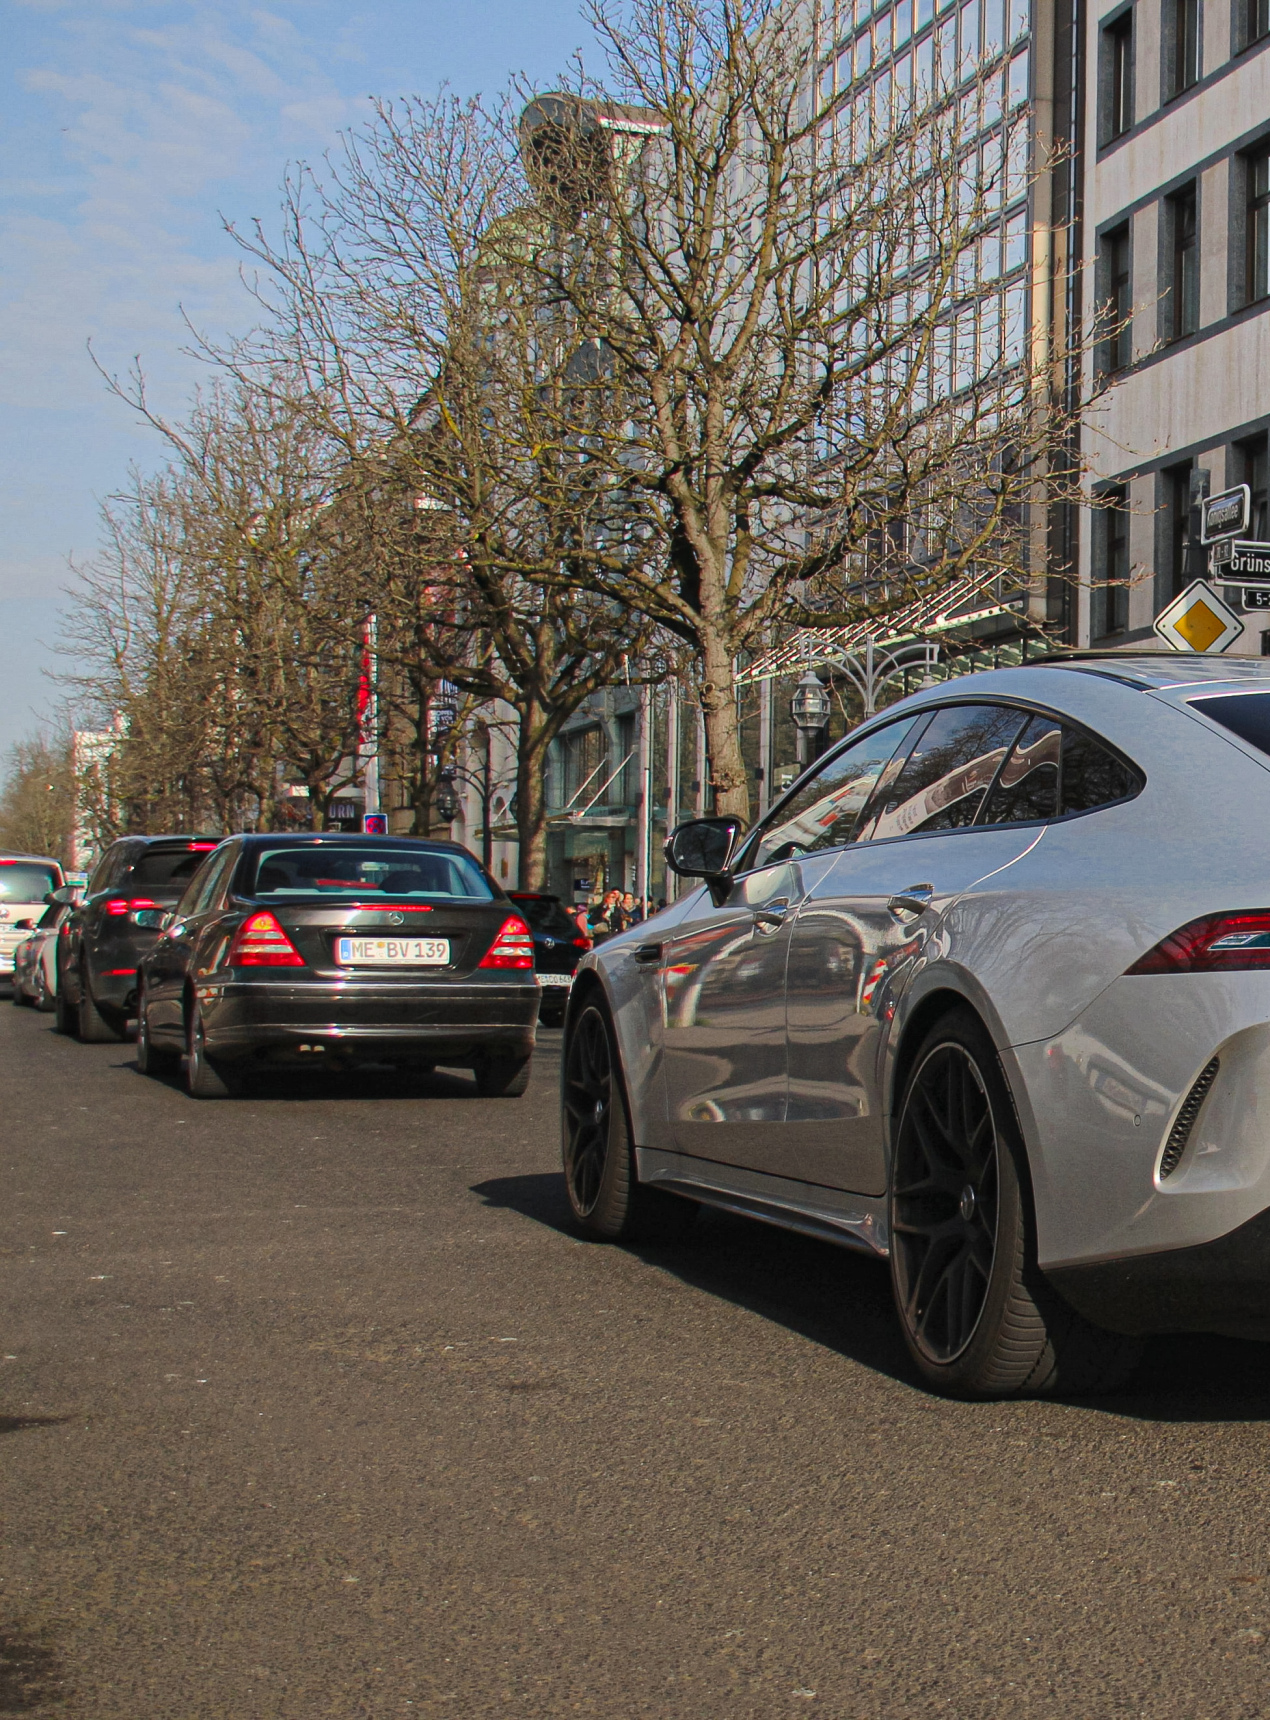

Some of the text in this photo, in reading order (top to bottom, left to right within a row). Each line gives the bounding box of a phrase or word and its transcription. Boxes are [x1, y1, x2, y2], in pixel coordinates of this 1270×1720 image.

[352, 942, 446, 958] ME BV 139
